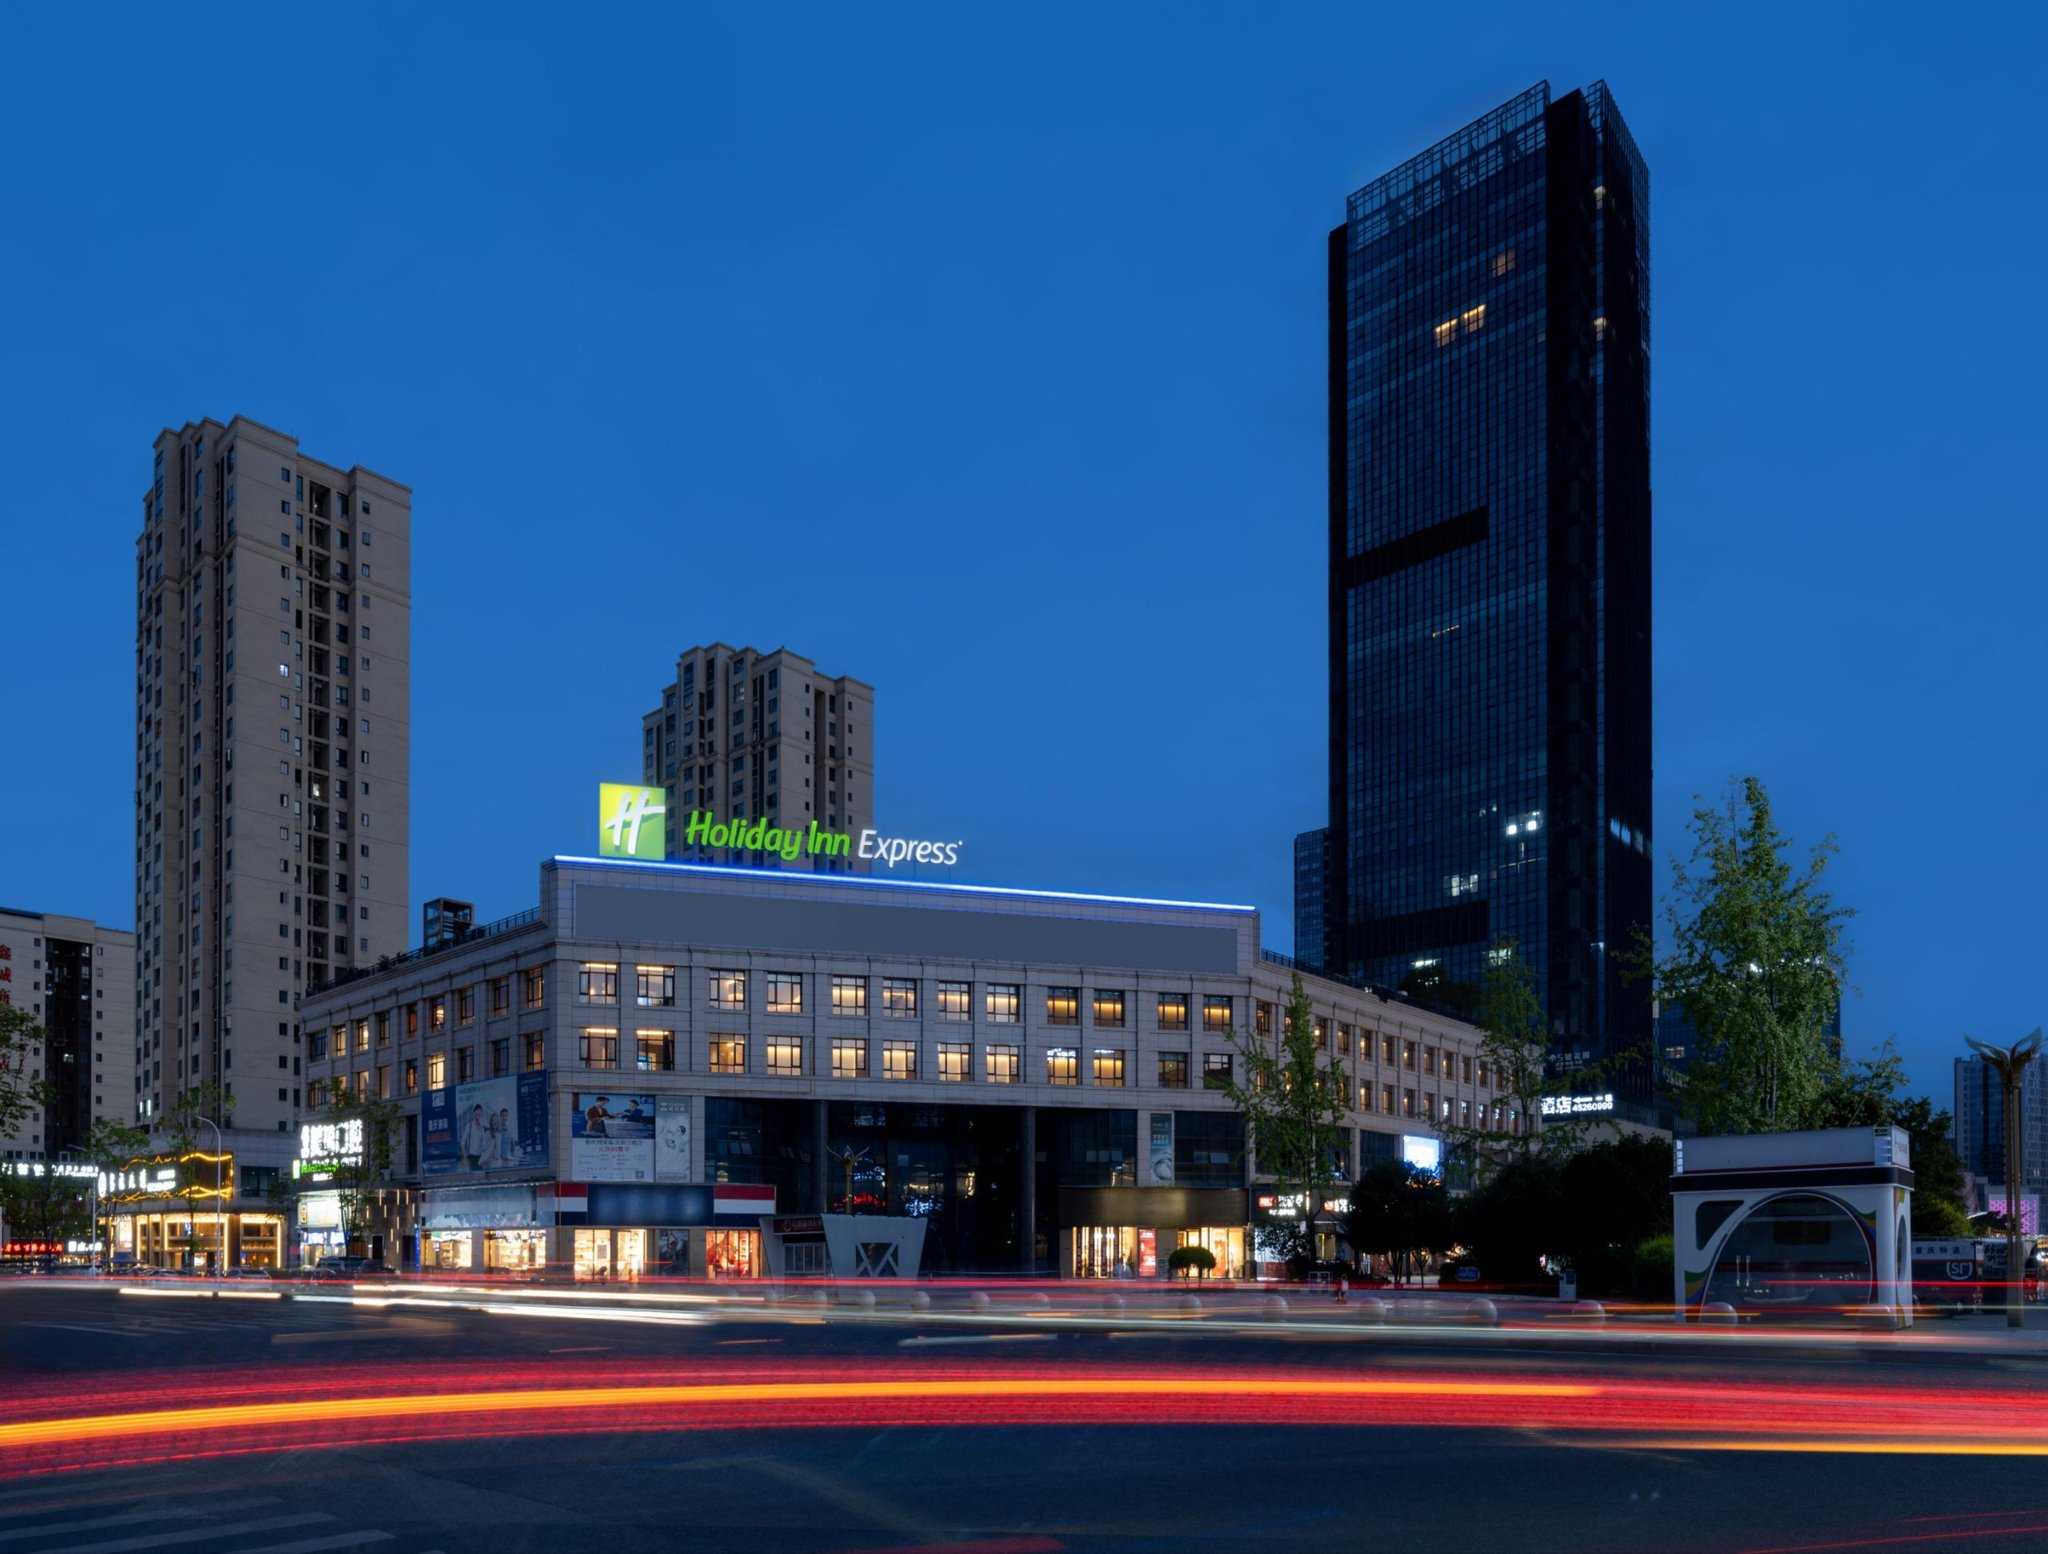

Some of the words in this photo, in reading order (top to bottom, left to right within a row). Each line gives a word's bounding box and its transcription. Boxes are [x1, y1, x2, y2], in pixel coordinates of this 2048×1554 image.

[686, 810, 803, 862] Holiday
[807, 820, 851, 857] Inn
[857, 829, 959, 868] Express
